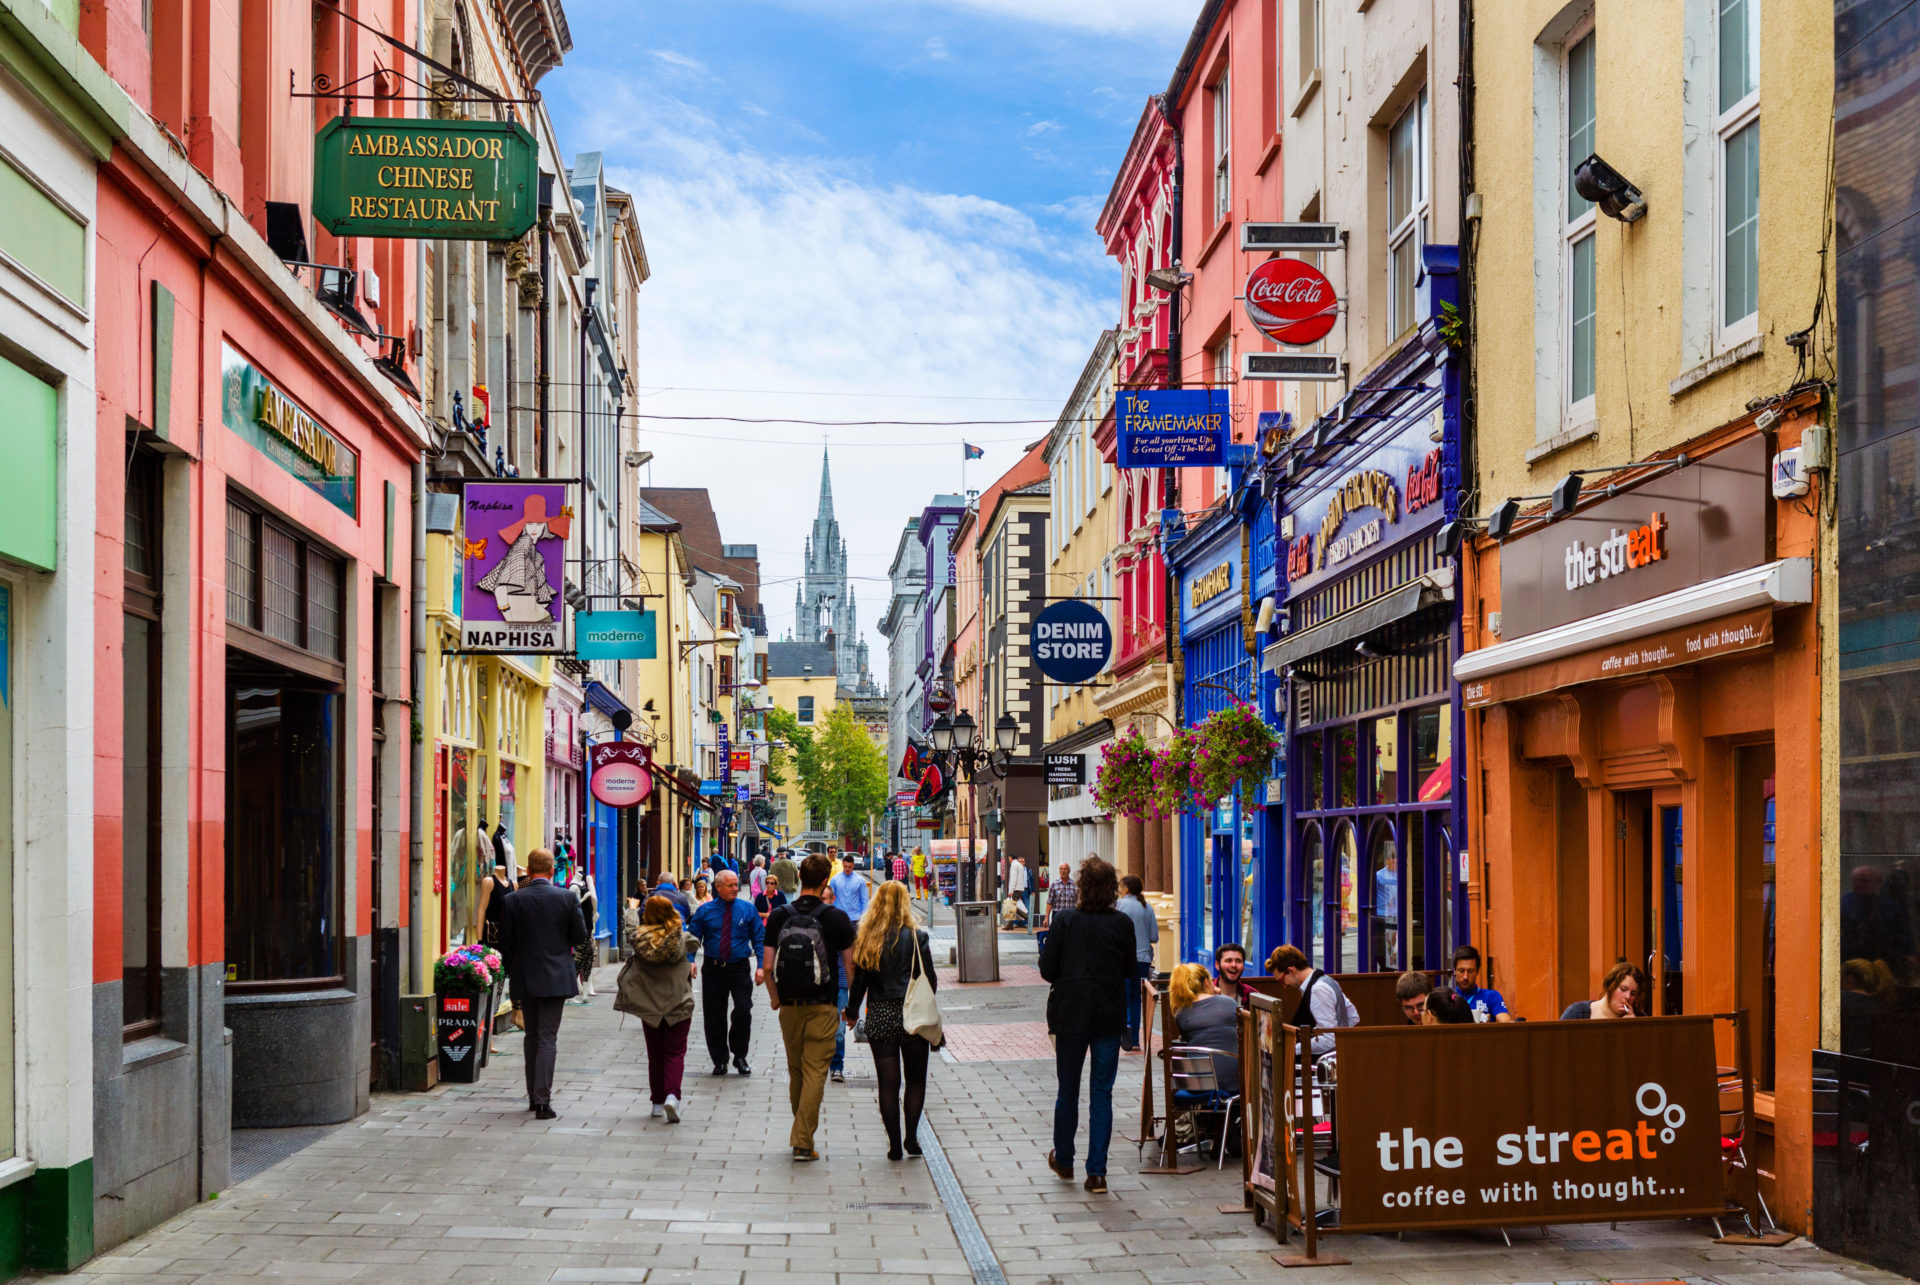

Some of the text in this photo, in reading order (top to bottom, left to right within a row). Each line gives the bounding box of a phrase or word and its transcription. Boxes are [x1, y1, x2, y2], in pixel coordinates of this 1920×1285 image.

[348, 134, 504, 160] AMBASSADOR
[378, 166, 473, 189] CHINESE
[349, 196, 500, 222] RESTAURANT
[1250, 277, 1325, 303] Coca-Cola
[1125, 395, 1149, 413] The
[260, 385, 336, 476] AMBASSADOR
[1125, 414, 1222, 431] FRAMEMAKER
[1135, 437, 1148, 445] For
[468, 500, 514, 512] Naphisa
[1348, 518, 1381, 556] CHICKEN
[1565, 512, 1661, 590] the streat
[467, 631, 555, 646] NAPHISA
[588, 630, 644, 641] moderne
[1037, 622, 1103, 639] DENIM
[1037, 643, 1103, 659] STORE
[1602, 656, 1622, 670] coffee
[1624, 654, 1639, 666] with
[1686, 635, 1700, 653] food
[1703, 633, 1719, 648] with
[719, 733, 728, 758] Hair
[1048, 756, 1078, 764] LUSH
[445, 1001, 467, 1011] sale
[438, 1018, 477, 1027] PRADA
[1376, 1120, 1657, 1171] the streat
[1382, 1176, 1685, 1207] coffee with thought...
